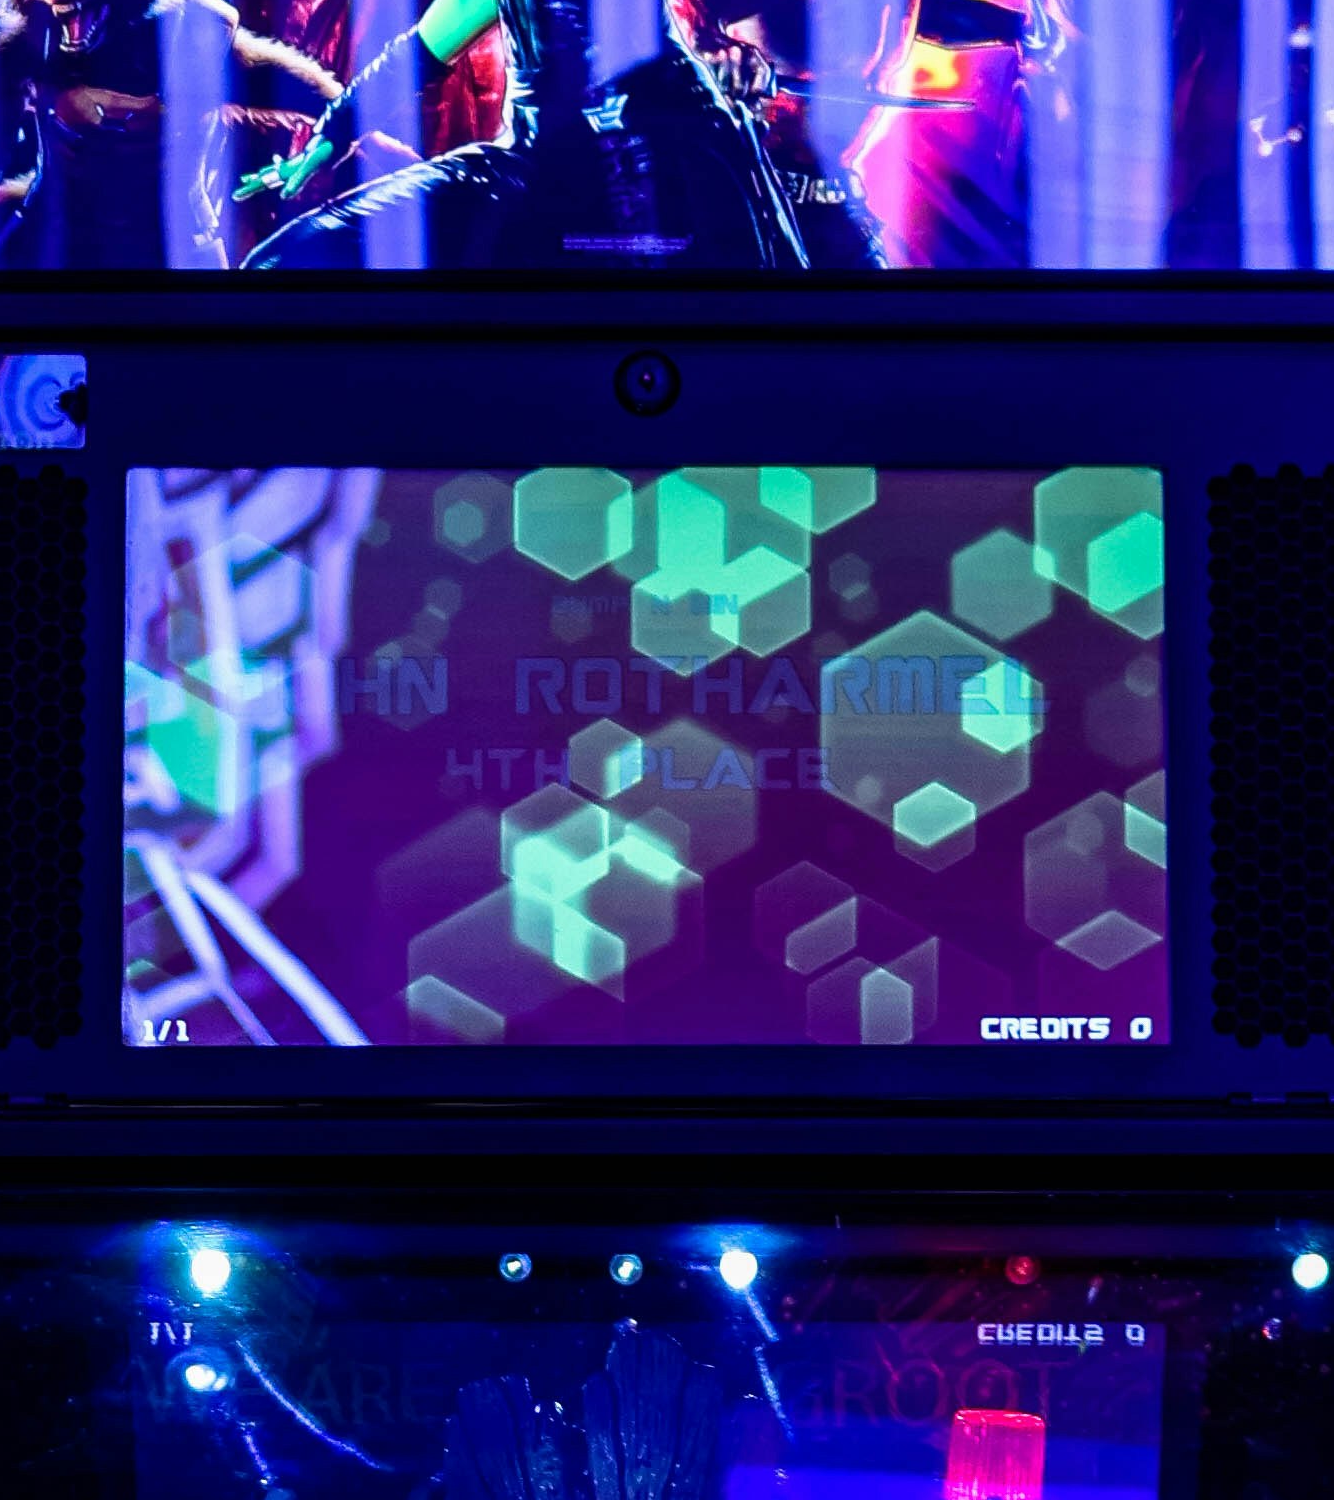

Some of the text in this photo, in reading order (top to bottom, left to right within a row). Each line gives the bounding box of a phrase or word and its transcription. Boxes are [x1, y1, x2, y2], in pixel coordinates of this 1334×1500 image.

[514, 655, 1051, 715] ROTHARMEL
[620, 747, 836, 791] PLACE
[143, 1019, 190, 1042] 1/1
[980, 1017, 1111, 1040] CREDITS
